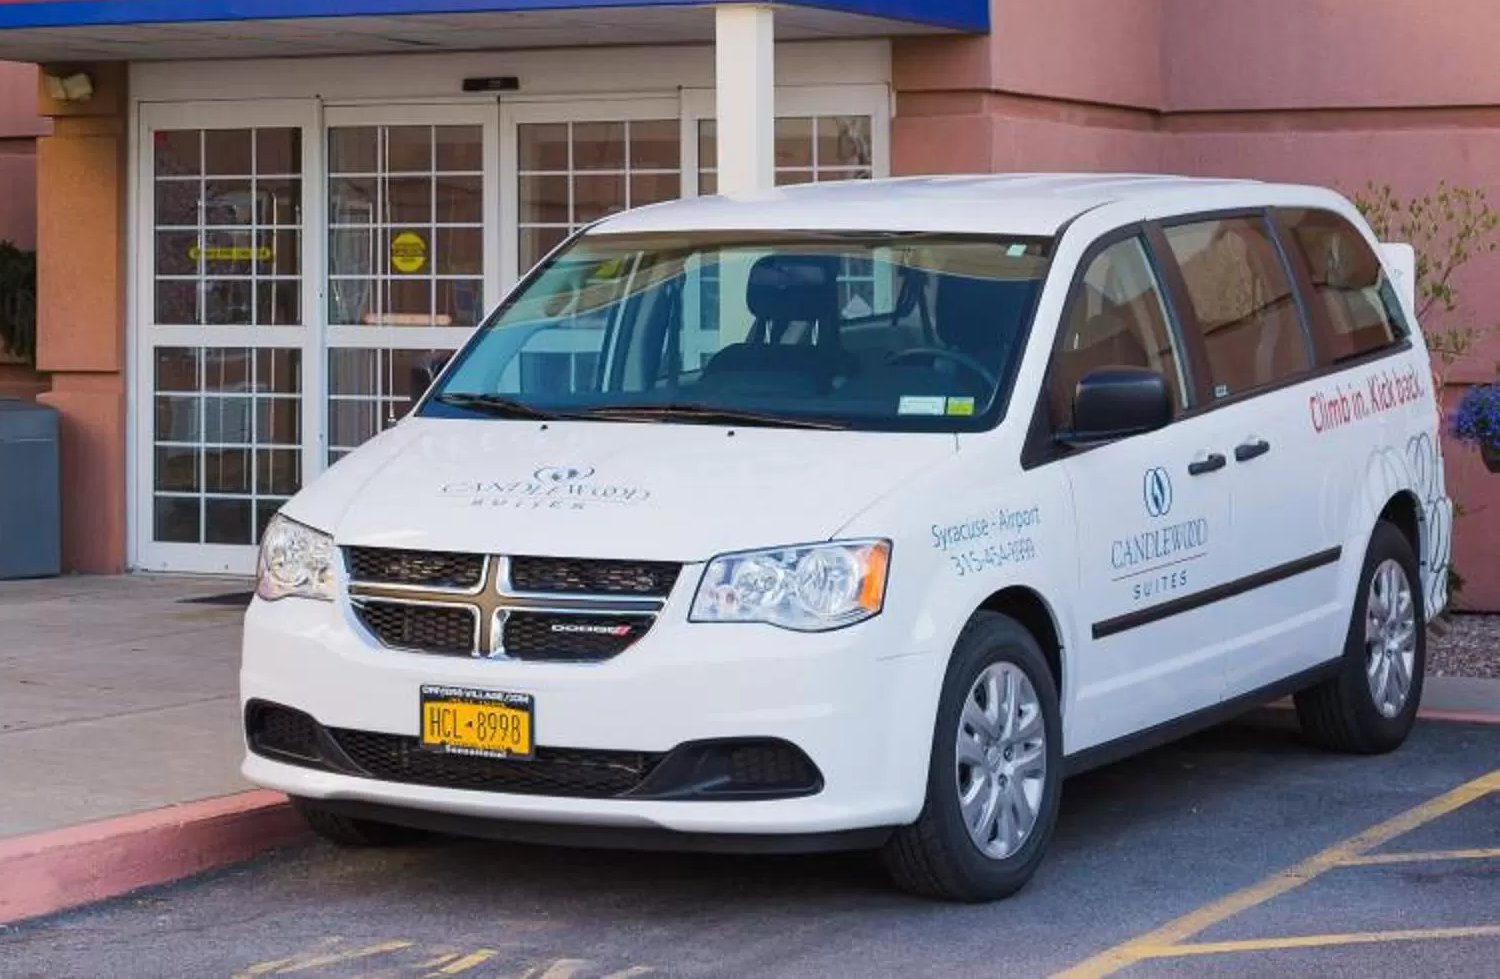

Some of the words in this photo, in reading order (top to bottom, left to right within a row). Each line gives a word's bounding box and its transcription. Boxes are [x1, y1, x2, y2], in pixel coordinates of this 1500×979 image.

[1309, 386, 1351, 433] Climb
[931, 518, 989, 551] Syracuse
[998, 505, 1040, 535] Airport
[1111, 518, 1209, 569] CANDLEWOOD
[1132, 570, 1188, 600] SUITES
